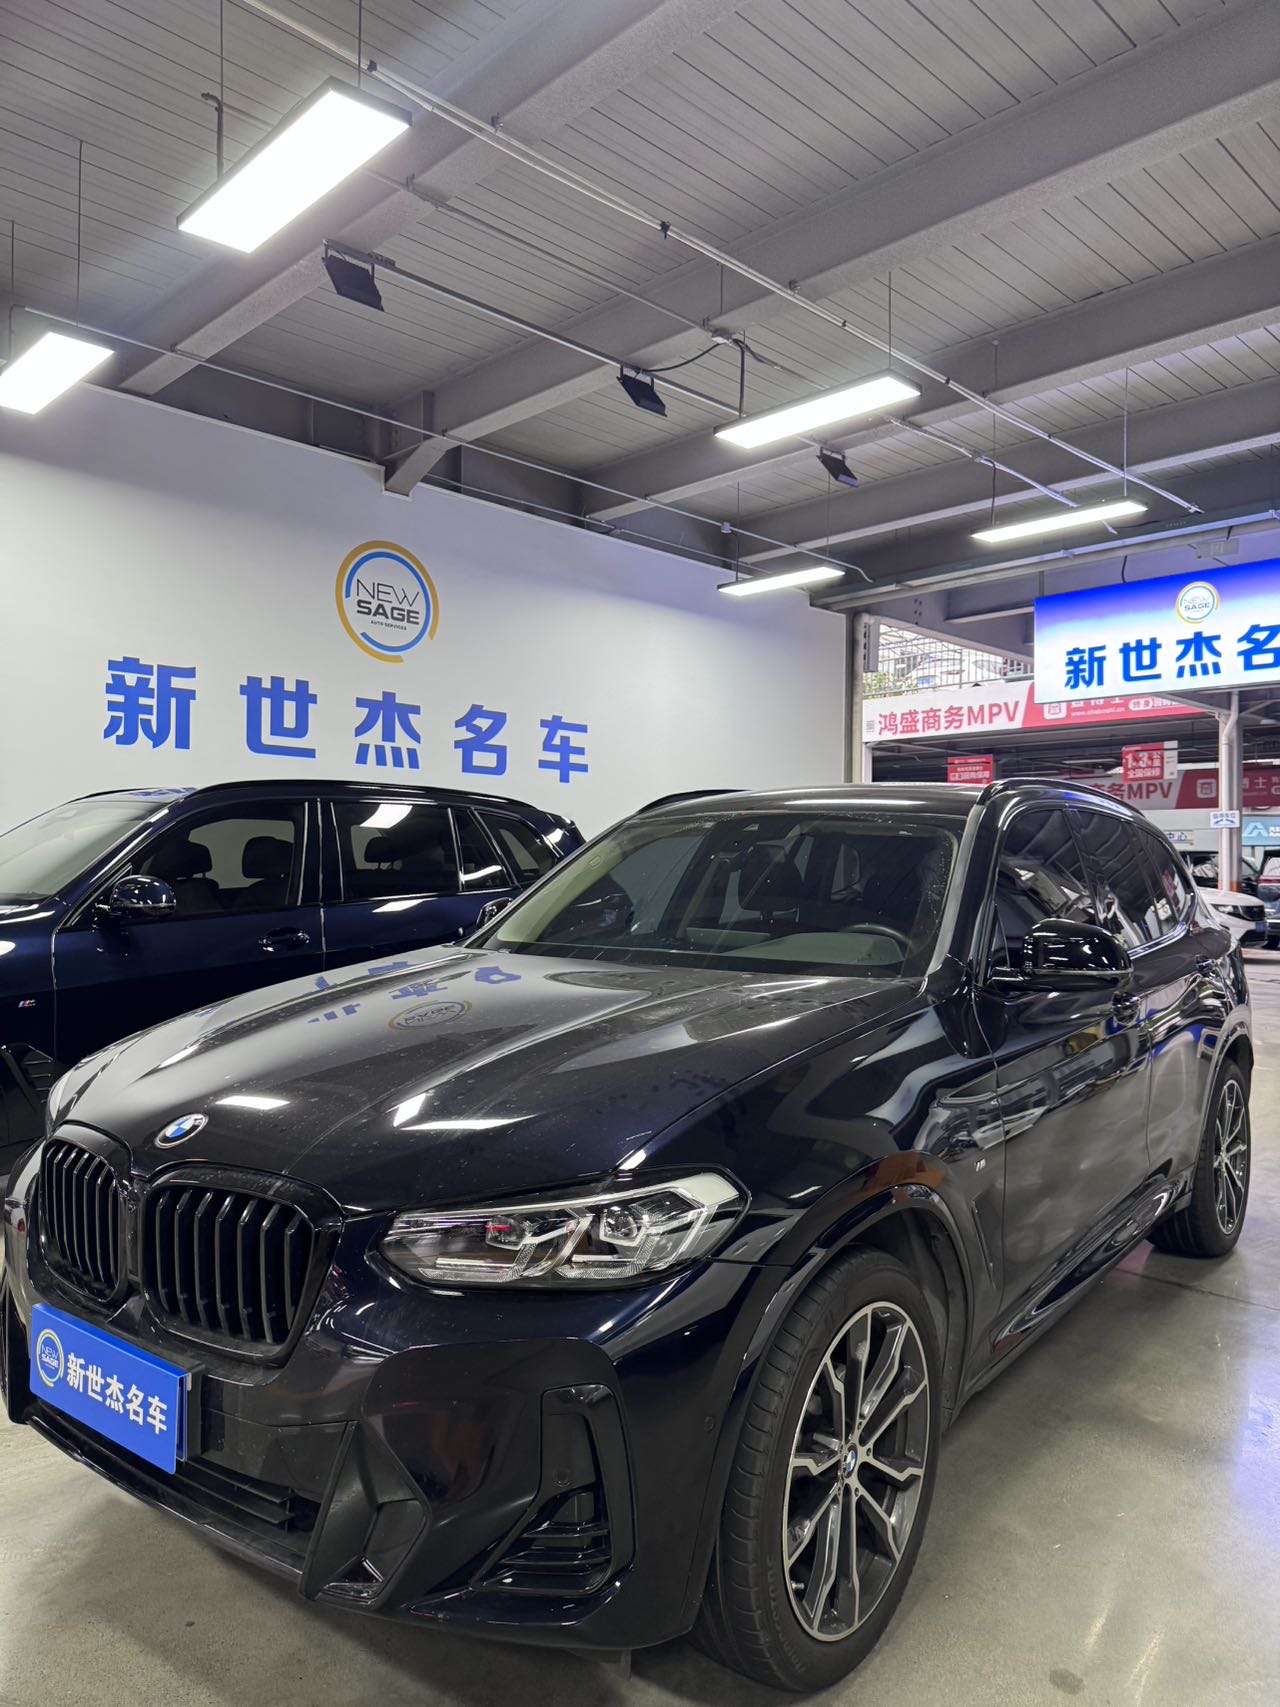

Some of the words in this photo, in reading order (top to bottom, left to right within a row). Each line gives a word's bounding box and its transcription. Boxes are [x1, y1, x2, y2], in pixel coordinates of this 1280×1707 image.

[356, 578, 420, 607] NEW
[1184, 602, 1211, 611] SAGE
[356, 599, 420, 625] SAGE
[1064, 623, 1280, 690] 新世杰名
[103, 656, 590, 785] 新世杰名车
[877, 701, 1020, 737] 鸿盛商务MPV
[41, 1344, 59, 1360] NEW
[41, 1353, 59, 1369] SAGE
[67, 1351, 168, 1435] 新世杰名车
